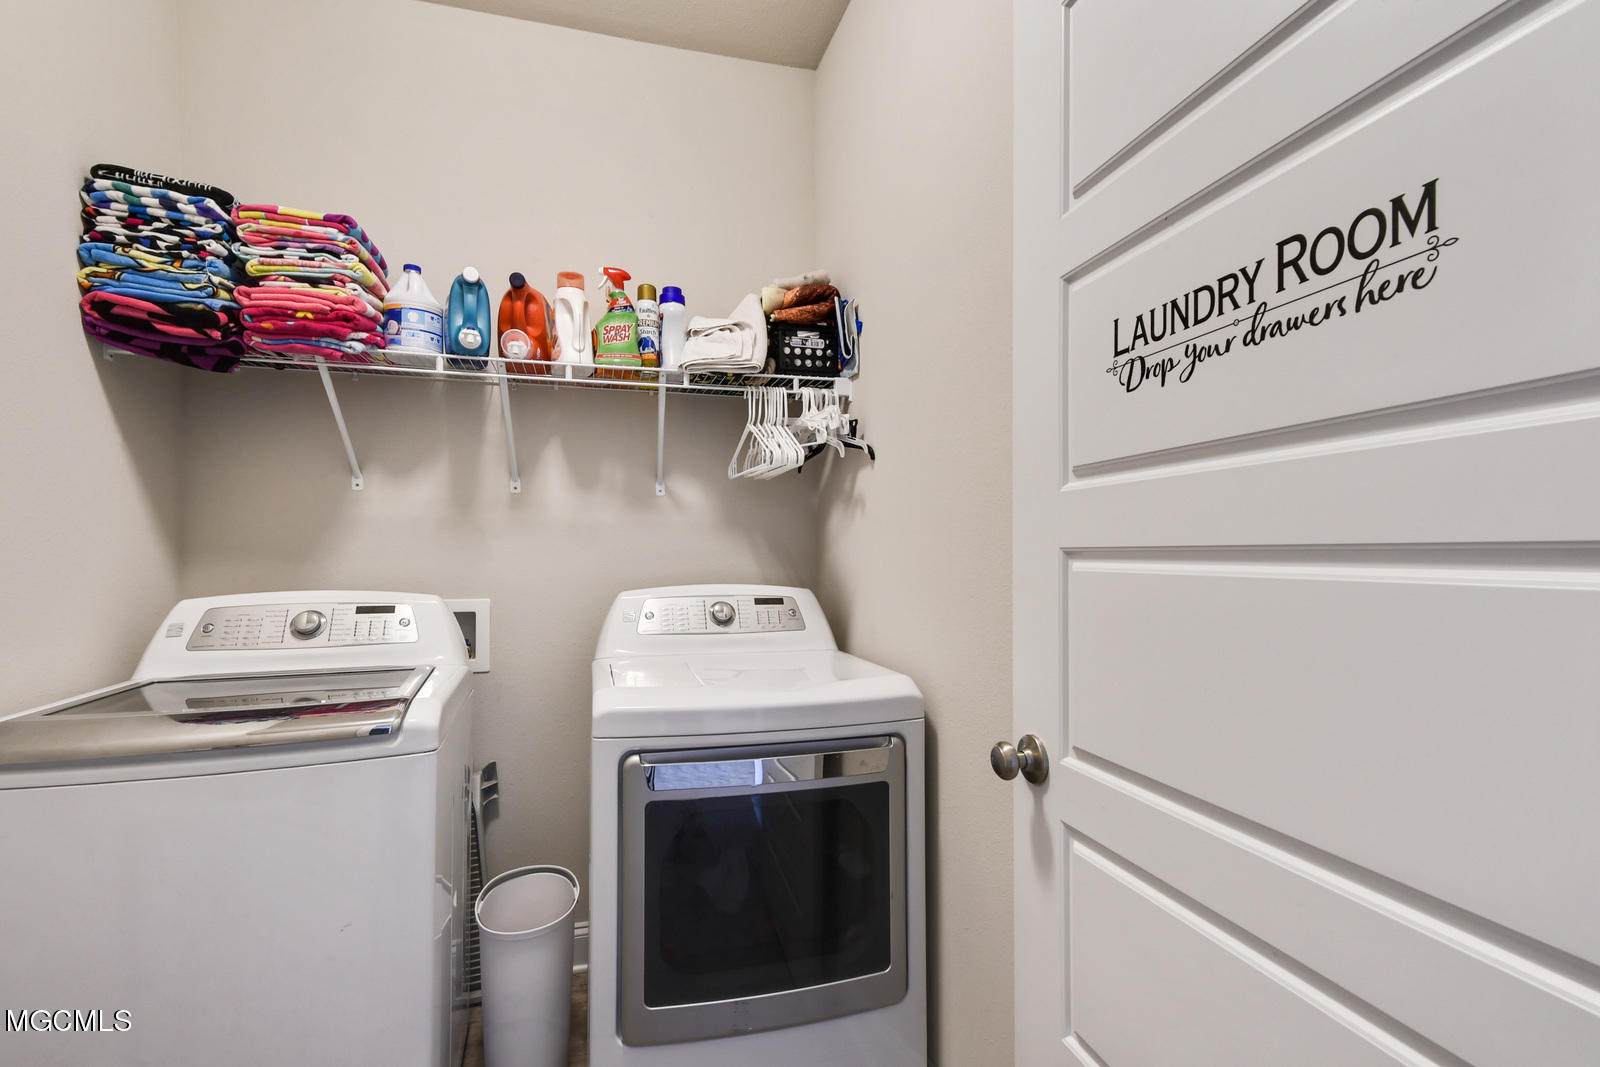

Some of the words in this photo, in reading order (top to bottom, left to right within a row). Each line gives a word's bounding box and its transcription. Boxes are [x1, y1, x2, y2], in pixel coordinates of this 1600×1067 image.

[1113, 257, 1265, 358] LAUNDRY
[1275, 178, 1439, 293] ROOM
[603, 324, 634, 336] SPRAY
[603, 333, 631, 344] WASH
[1119, 355, 1181, 393] Drop
[1180, 335, 1237, 383] your
[1243, 302, 1348, 347] drawers
[1355, 259, 1438, 313] here
